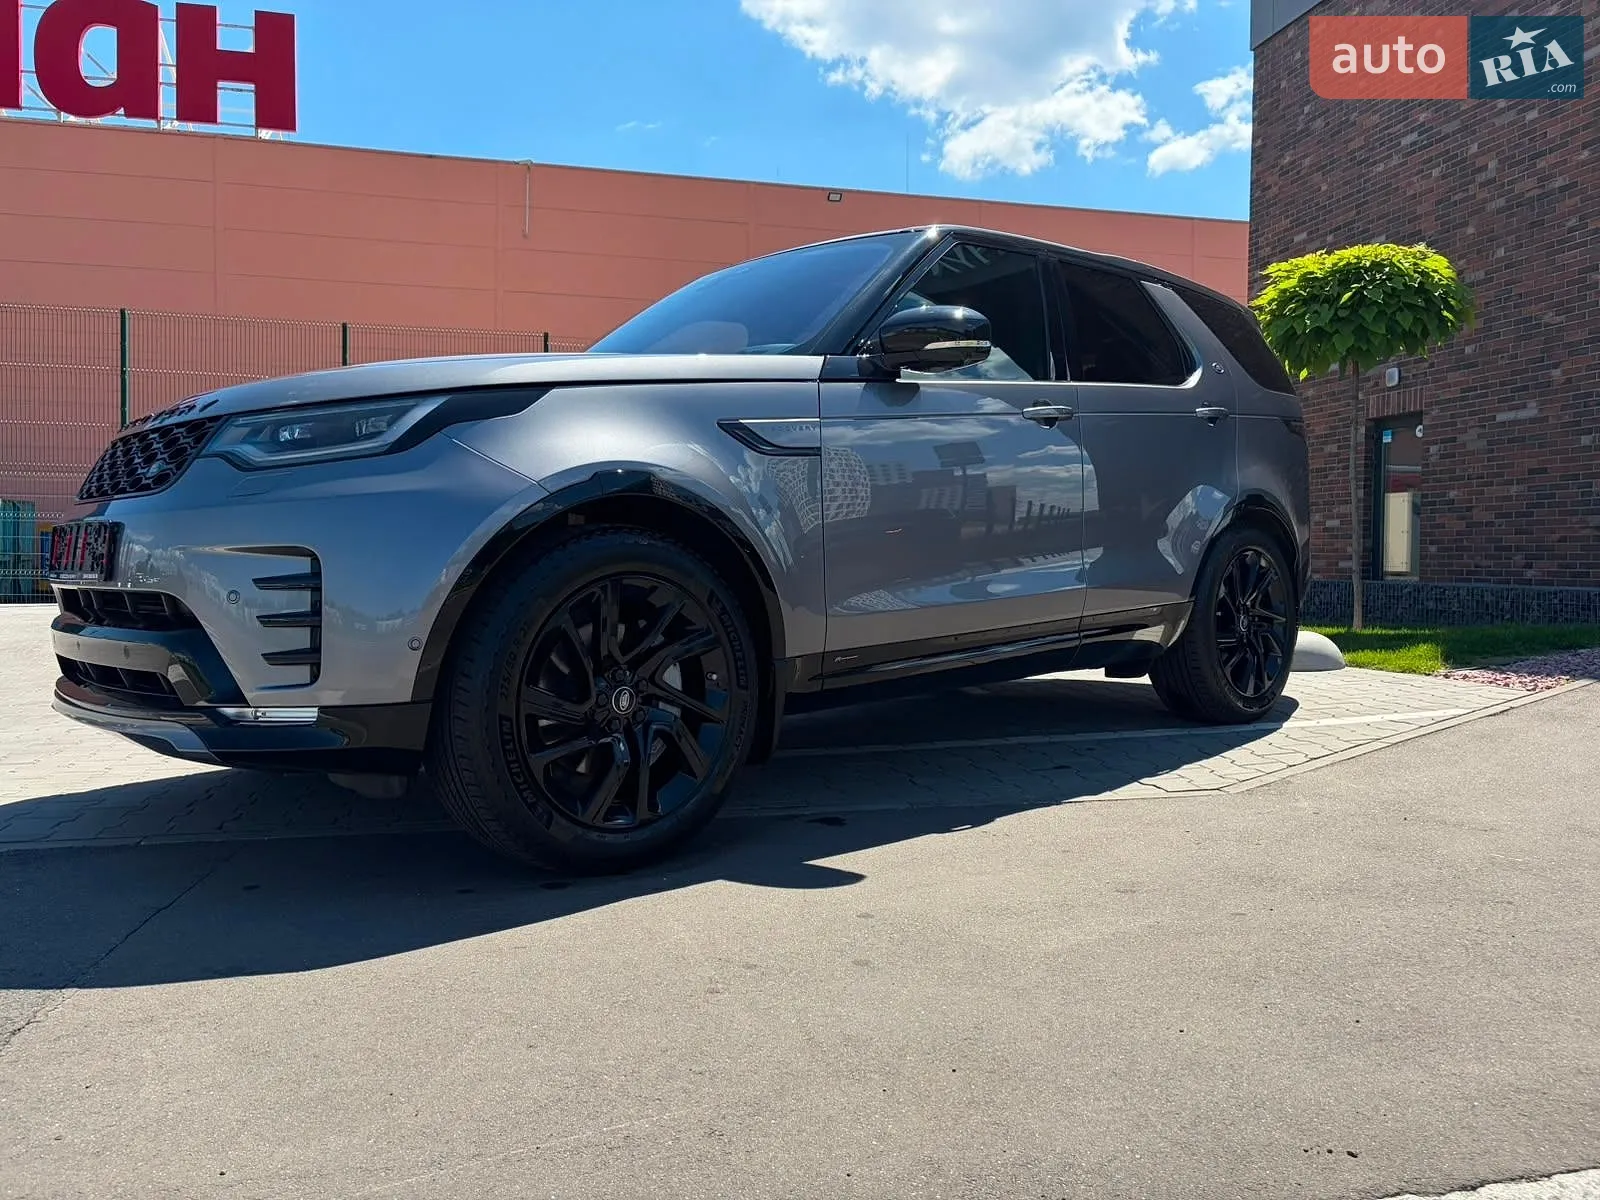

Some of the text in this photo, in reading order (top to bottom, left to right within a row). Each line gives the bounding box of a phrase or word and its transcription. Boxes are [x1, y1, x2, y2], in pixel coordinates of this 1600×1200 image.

[0, 0, 296, 132] ан
[760, 423, 816, 432] COVERY
[500, 718, 538, 805] MICHELIN
